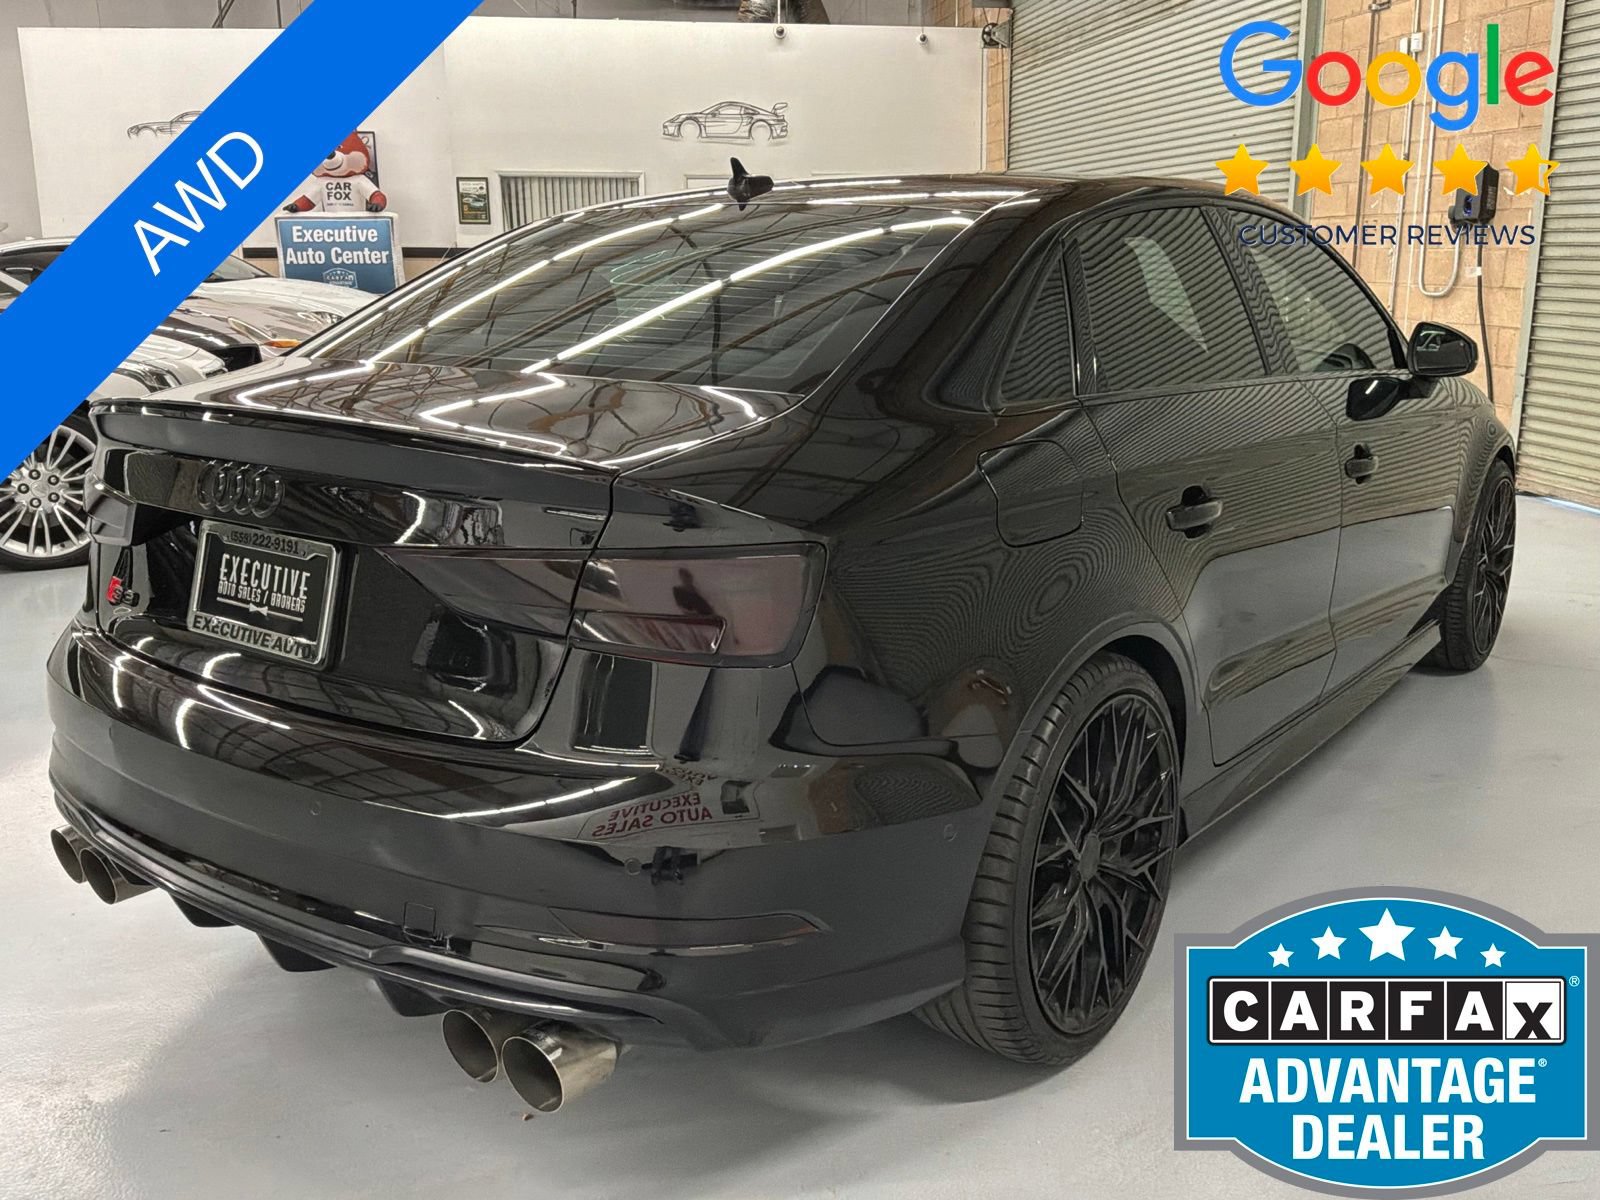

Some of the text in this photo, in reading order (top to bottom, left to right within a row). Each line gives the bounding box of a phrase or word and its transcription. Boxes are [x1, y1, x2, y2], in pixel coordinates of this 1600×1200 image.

[326, 182, 352, 191] CAR
[327, 191, 352, 201] FOX
[292, 225, 378, 242] Executive
[286, 247, 389, 265] Auto Center
[219, 553, 311, 600] EXECUTIVE
[217, 580, 236, 597] AUTO
[237, 584, 261, 603] SALES
[270, 592, 306, 614] BROKERS
[192, 615, 312, 659] EXECUTIVE AUTO
